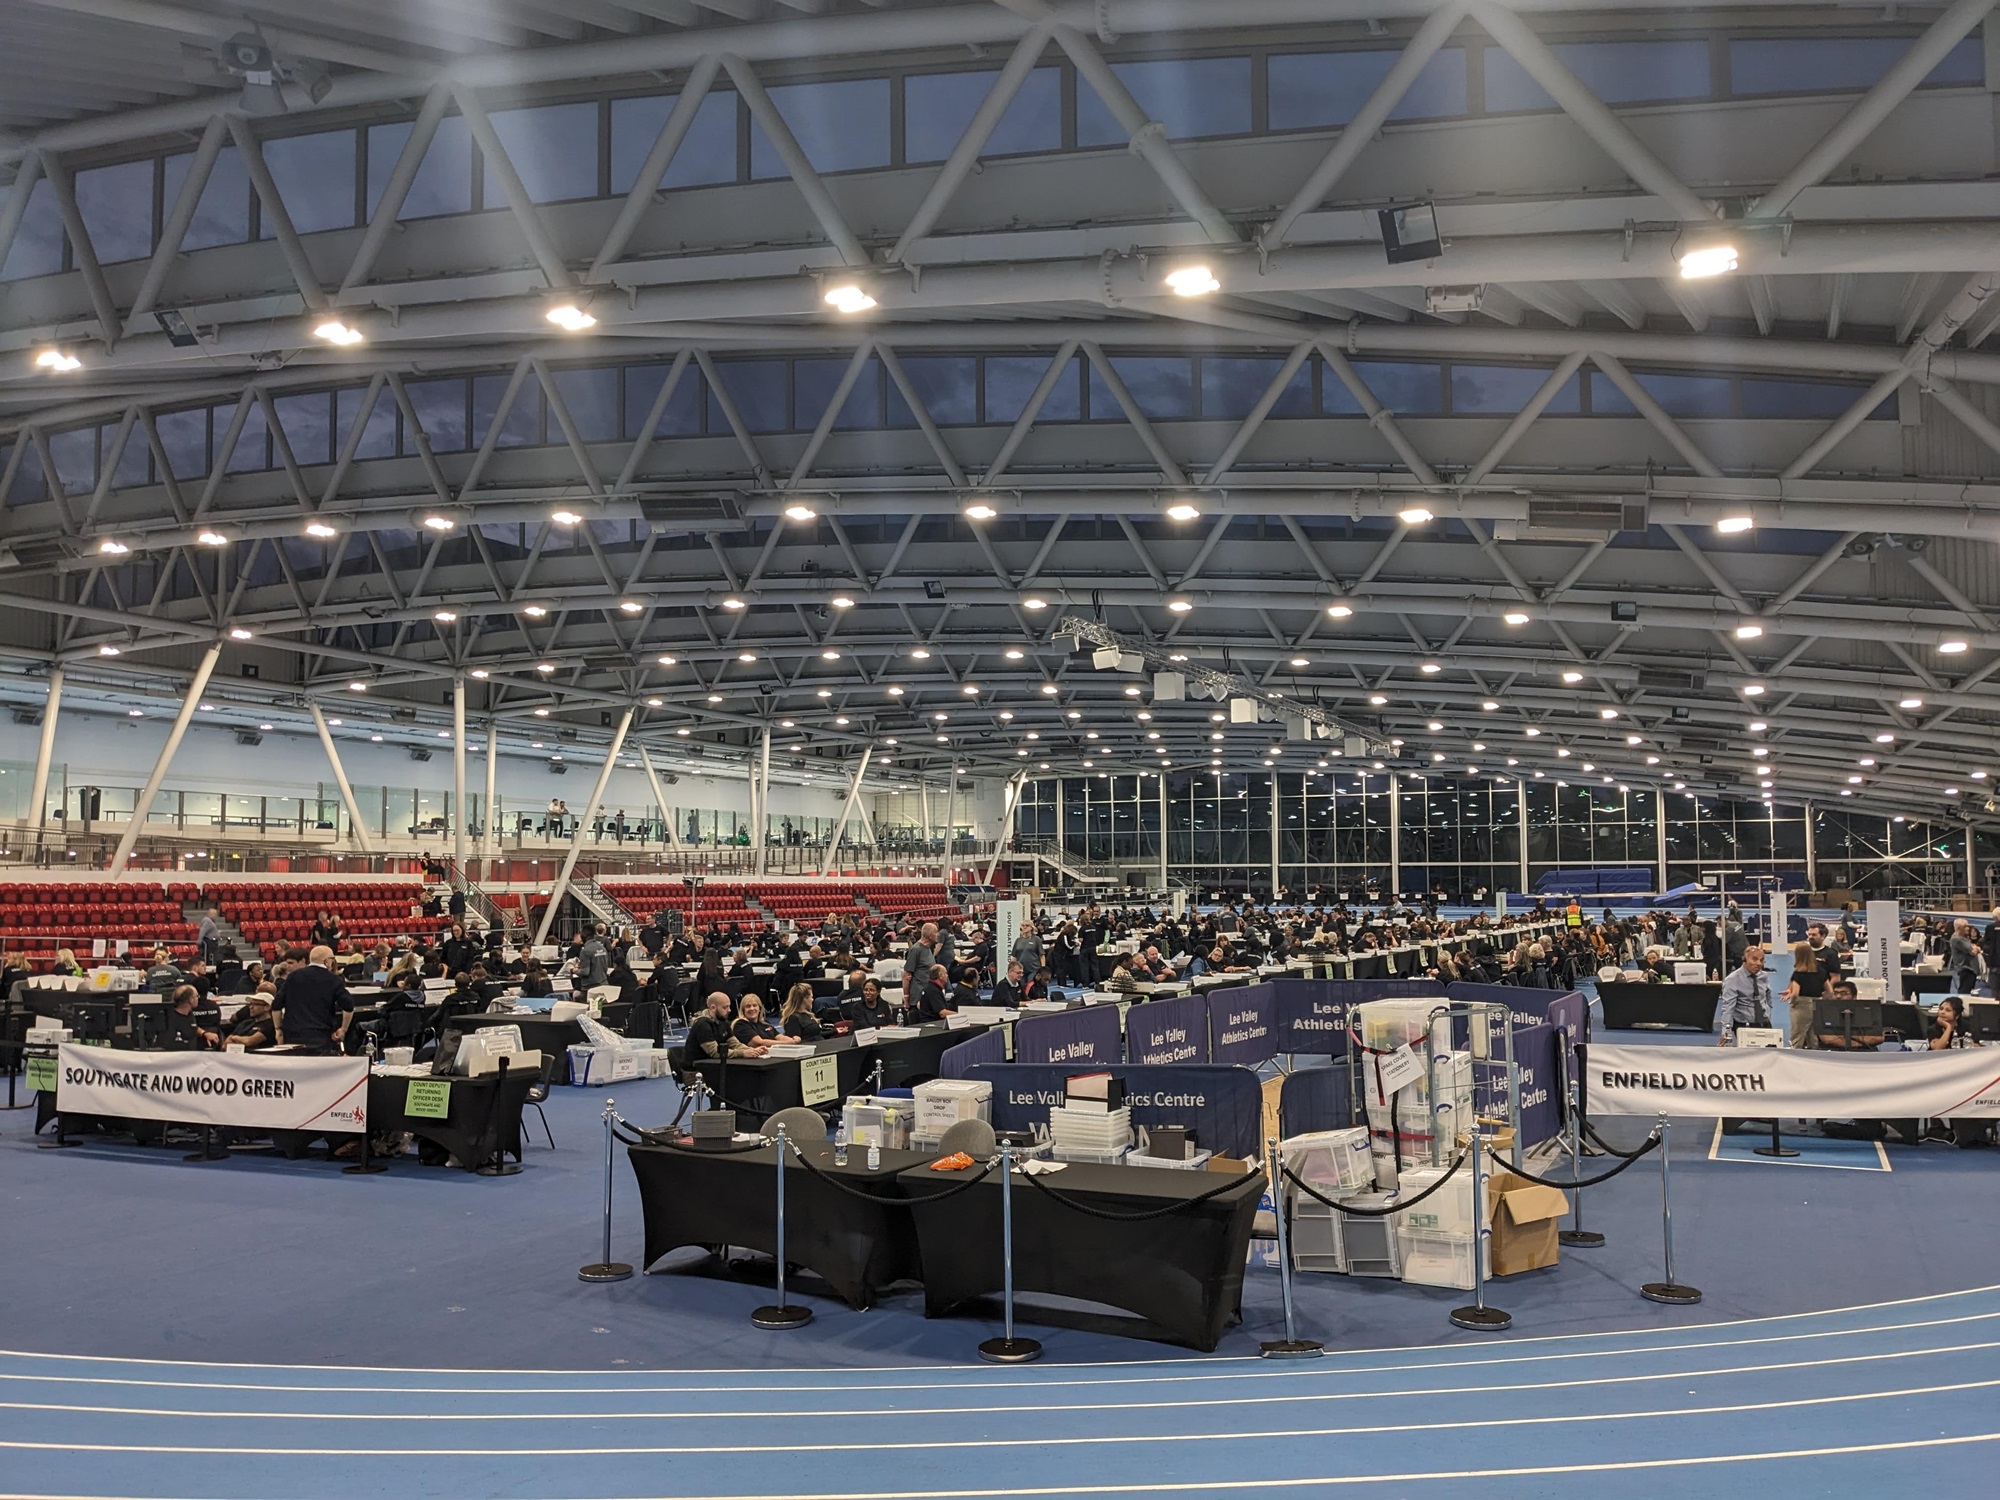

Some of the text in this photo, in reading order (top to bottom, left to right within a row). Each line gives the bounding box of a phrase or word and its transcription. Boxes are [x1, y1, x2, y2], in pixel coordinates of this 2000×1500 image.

[1313, 1002, 1341, 1014] Lee
[1229, 1013, 1241, 1026] Lee
[1293, 1018, 1362, 1031] Athletis
[1151, 1028, 1186, 1047] Lee Valley
[1221, 1030, 1249, 1046] Athletics
[1049, 1041, 1095, 1063] Lee Valley
[1381, 1052, 1407, 1071] SPARE COUNT
[1386, 1060, 1410, 1077] STATIONERY
[66, 1067, 148, 1091] SOUTHGATE
[151, 1074, 183, 1094] AND
[186, 1076, 238, 1097] WOOD
[241, 1078, 295, 1099] GREEN
[815, 1070, 823, 1082] 11
[1602, 1071, 1766, 1092] ENFIELD NORTH
[1009, 1090, 1034, 1105] Lee
[1037, 1091, 1064, 1105] Vall
[1154, 1092, 1205, 1107] Centre
[330, 1111, 353, 1119] ENFIELD
